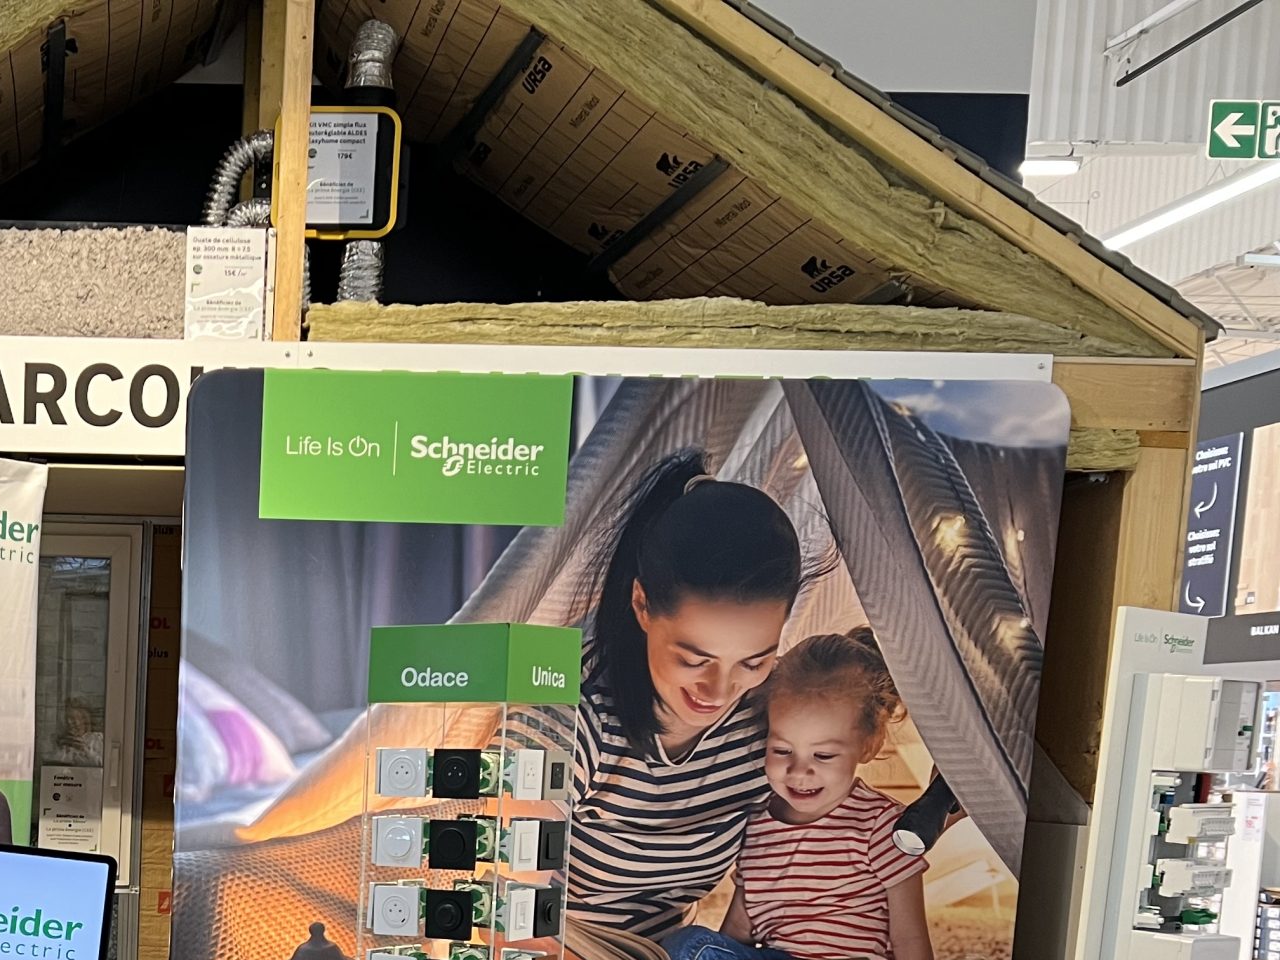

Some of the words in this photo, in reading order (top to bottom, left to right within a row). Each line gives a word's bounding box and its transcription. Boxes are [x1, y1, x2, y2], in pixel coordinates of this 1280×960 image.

[285, 435, 323, 456] Life
[326, 436, 345, 456] Is
[348, 435, 380, 457] On
[410, 434, 545, 461] Schneider
[467, 459, 539, 476] Electric
[1218, 457, 1232, 469] PVC
[1250, 624, 1280, 636] BALKAN
[1164, 634, 1195, 647] Schneider
[401, 667, 469, 687] Odace
[532, 665, 566, 689] Unica
